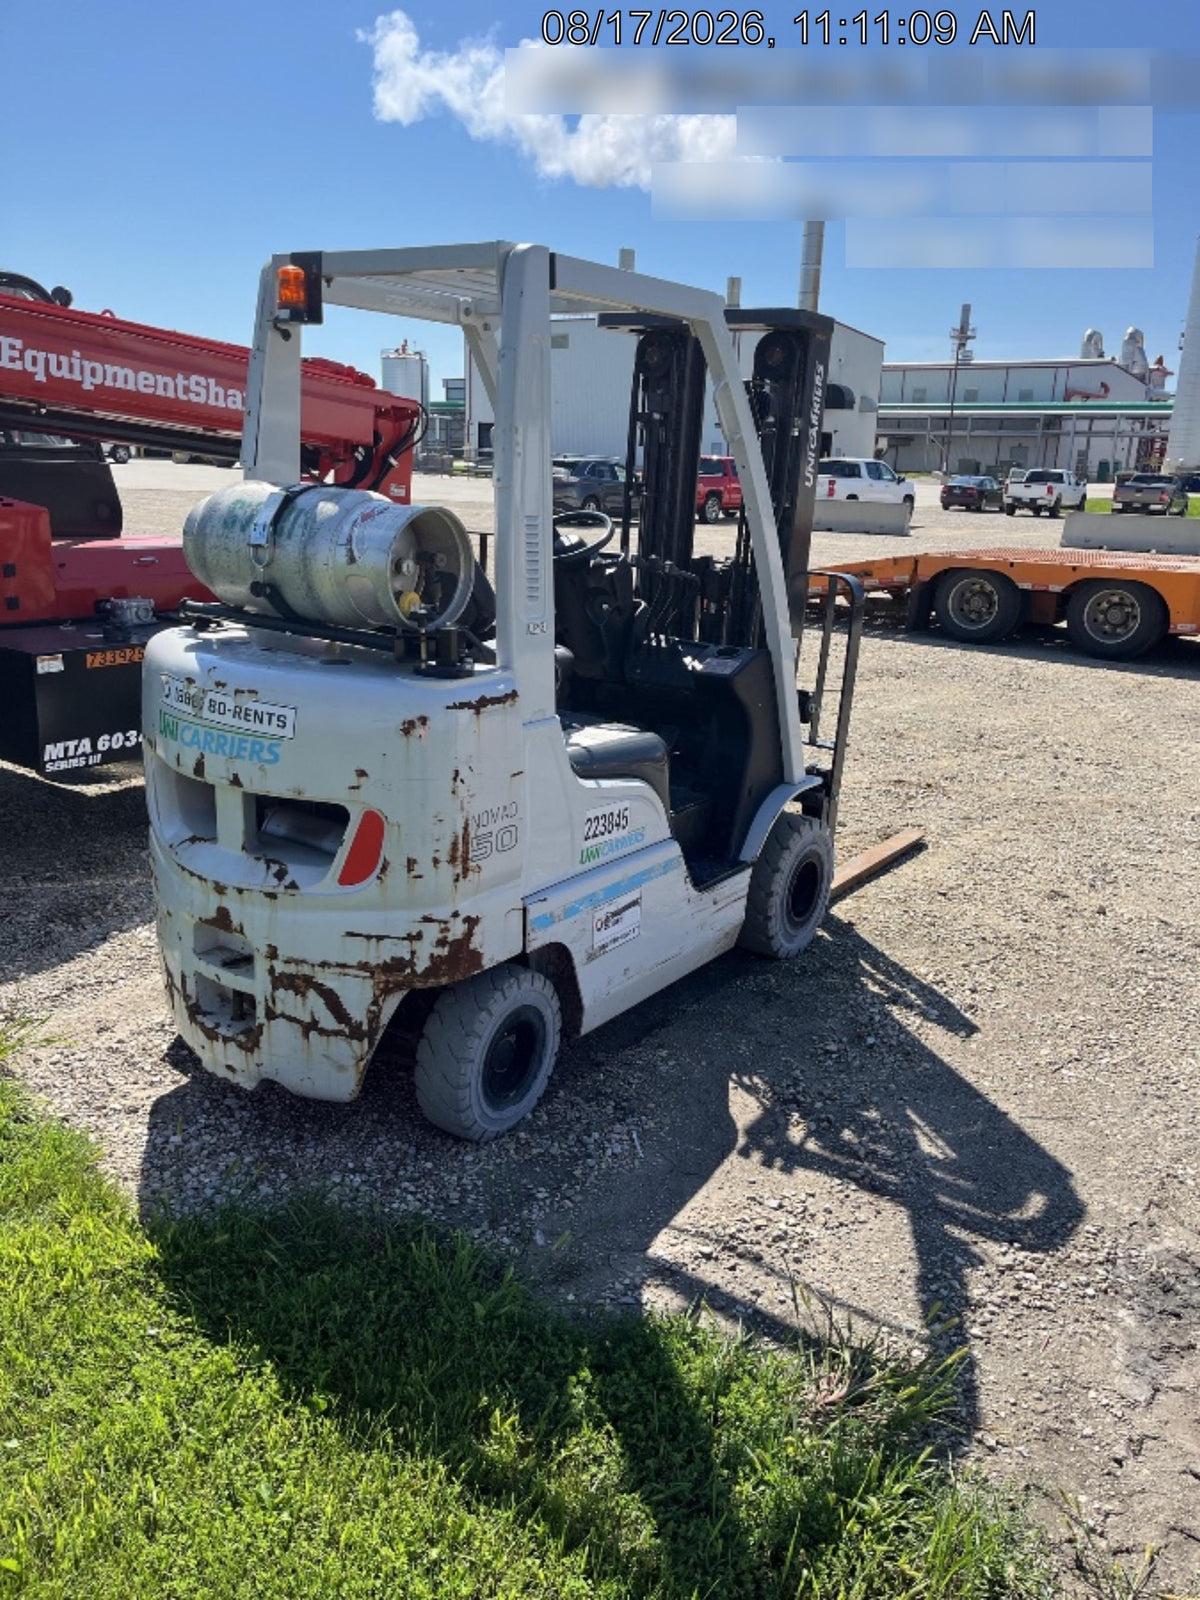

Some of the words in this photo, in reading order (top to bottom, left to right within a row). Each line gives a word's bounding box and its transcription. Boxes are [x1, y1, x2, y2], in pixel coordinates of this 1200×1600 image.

[0, 335, 247, 412] EquipmentSha
[804, 360, 825, 488] UNICARRIERS
[43, 737, 92, 762] MTA
[159, 709, 282, 766] UNICARRIERS
[45, 756, 87, 773] SERIES
[471, 824, 519, 863] 50
[583, 806, 629, 842] 223845
